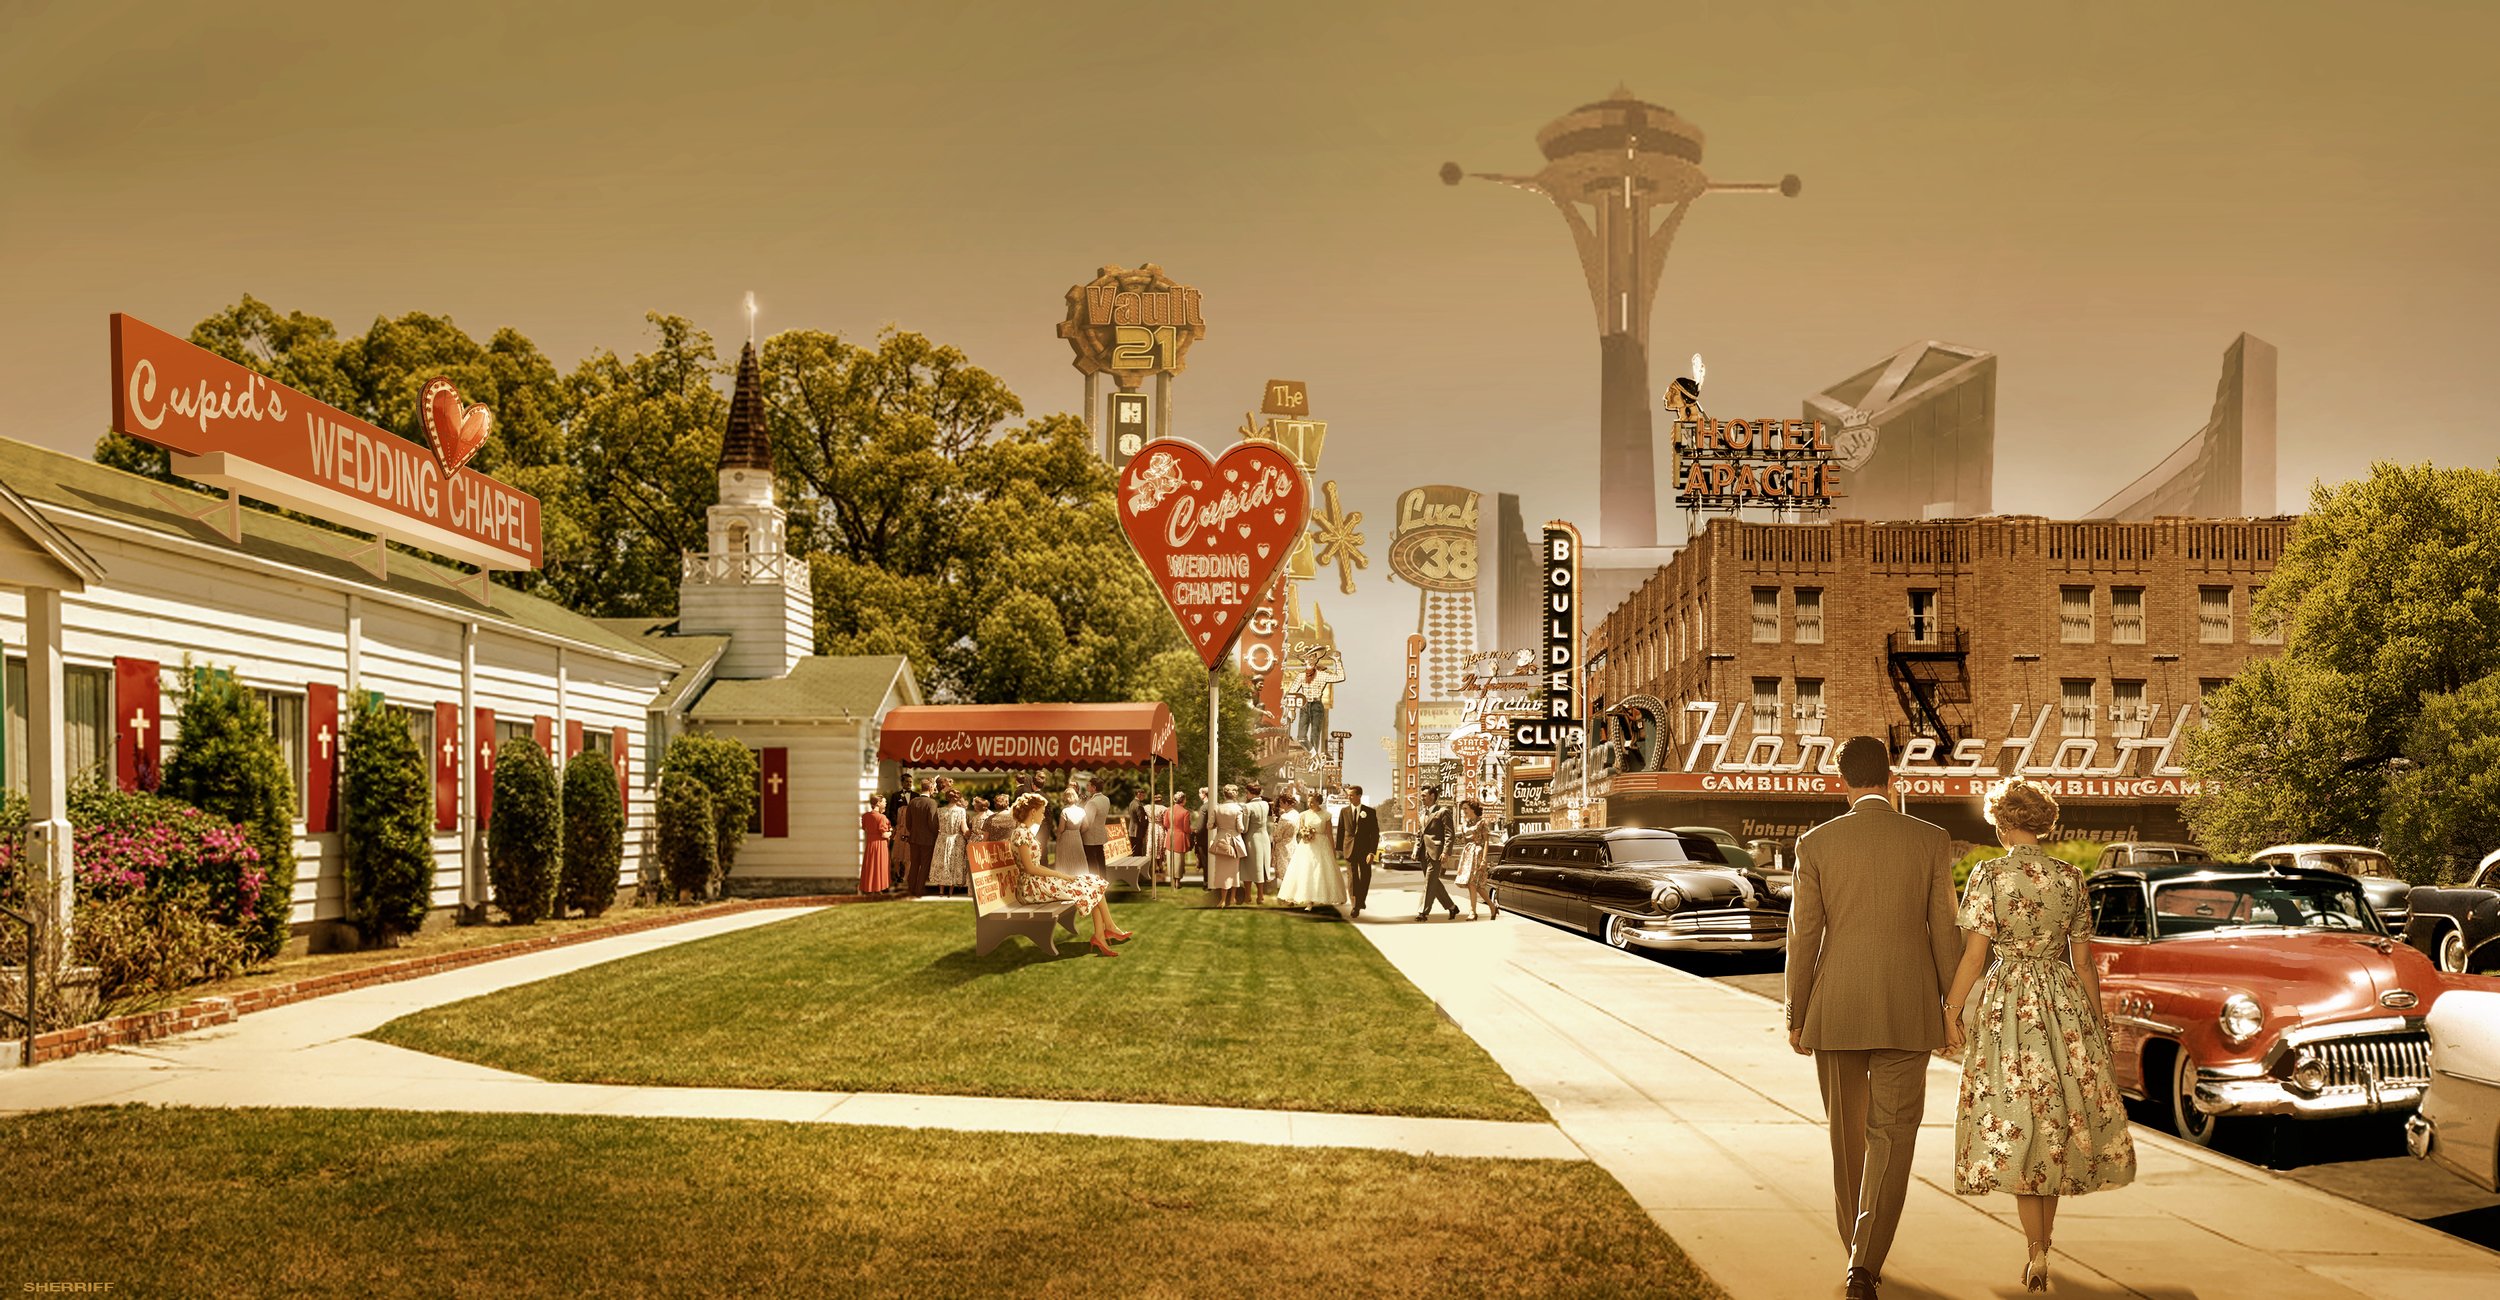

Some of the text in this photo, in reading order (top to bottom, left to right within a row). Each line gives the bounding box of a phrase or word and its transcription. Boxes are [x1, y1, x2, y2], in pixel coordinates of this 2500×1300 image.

[1086, 286, 1204, 325] Vault
[1112, 325, 1177, 369] 21
[1273, 385, 1304, 407] The
[1697, 418, 1834, 451] HOTEL
[129, 358, 533, 553] Cupid's WEDDING CHAPEL
[1684, 464, 1841, 497] APACHE
[1165, 465, 1293, 548] Cupid's
[1167, 553, 1250, 578] WEDDING
[1420, 538, 1478, 580] 38
[1173, 581, 1242, 605] CHAPEL
[1551, 539, 1572, 718] BOULDER
[1409, 643, 1417, 699] LAS
[1503, 696, 1543, 711] Club
[909, 731, 1132, 762] Cupid's WEDDING CHAPEL
[1457, 738, 1484, 746] STATE
[1517, 725, 1584, 746] CLUB
[1408, 708, 1417, 810] VEGAS
[1440, 761, 1457, 772] The
[1513, 782, 1542, 801] Enjoy
[1701, 775, 1826, 792] GAMBLING
